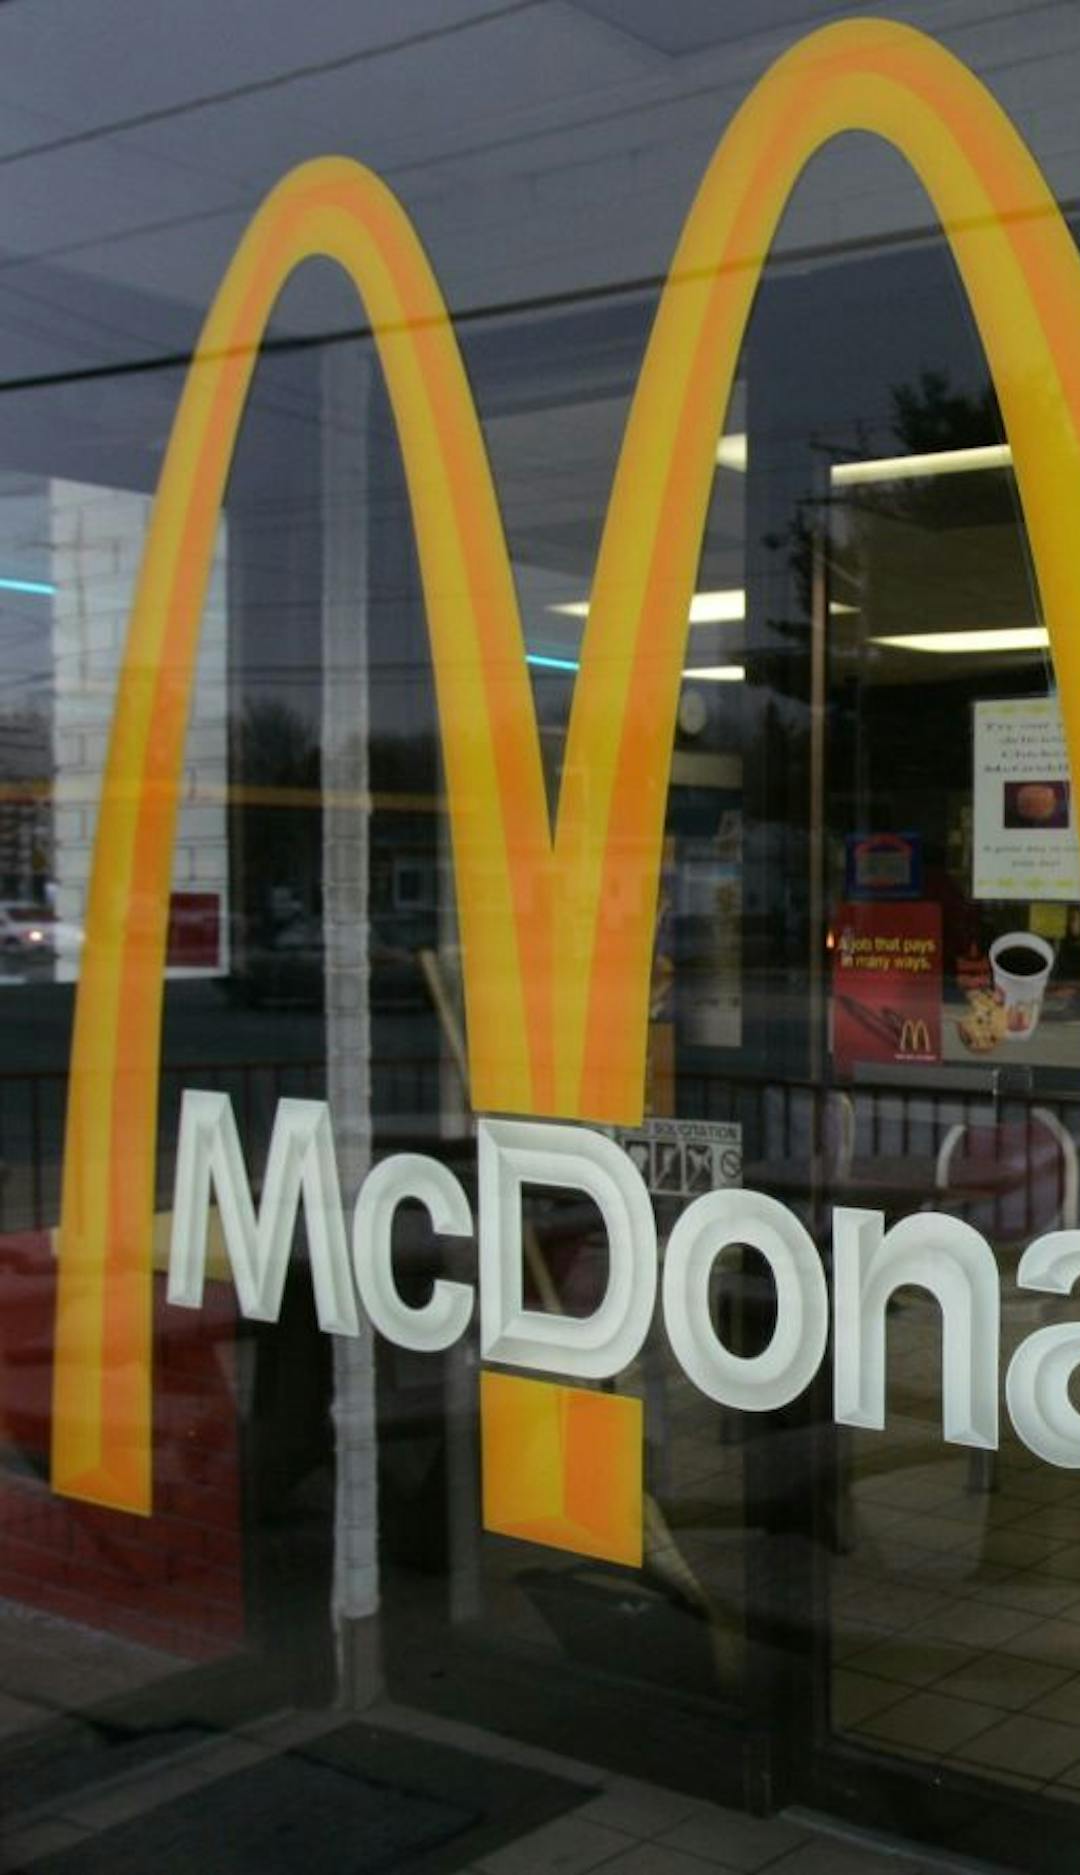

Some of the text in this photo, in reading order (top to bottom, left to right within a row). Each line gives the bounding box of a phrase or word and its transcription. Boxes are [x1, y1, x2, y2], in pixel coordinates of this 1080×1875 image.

[874, 937, 900, 951] that
[903, 938, 936, 954] pays
[856, 956, 890, 972] many
